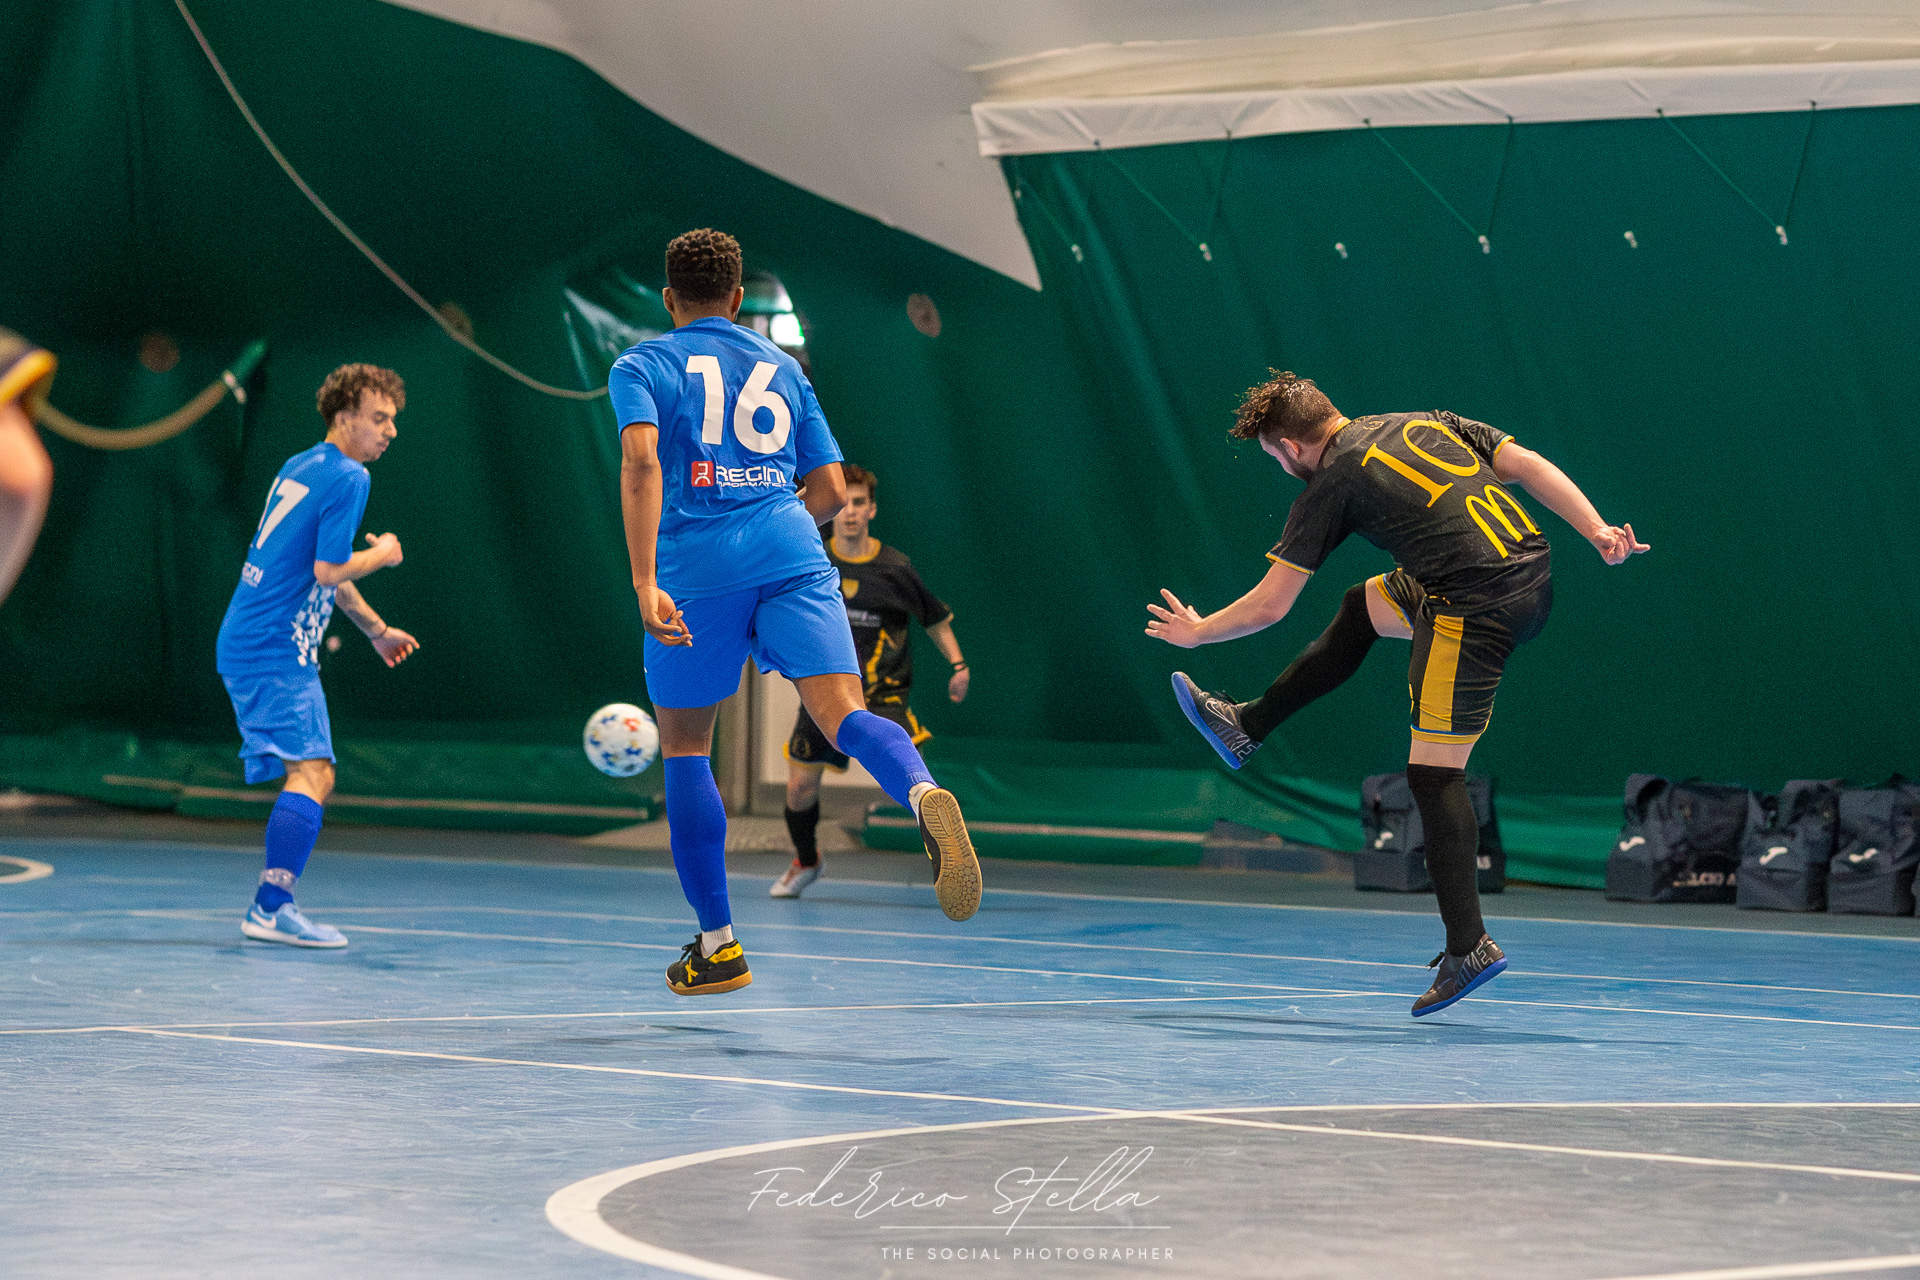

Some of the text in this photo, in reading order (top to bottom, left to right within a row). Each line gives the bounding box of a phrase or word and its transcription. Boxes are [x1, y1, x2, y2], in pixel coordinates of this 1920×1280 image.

[685, 355, 791, 455] 16
[715, 465, 787, 484] REGINI
[1361, 420, 1480, 507] 10
